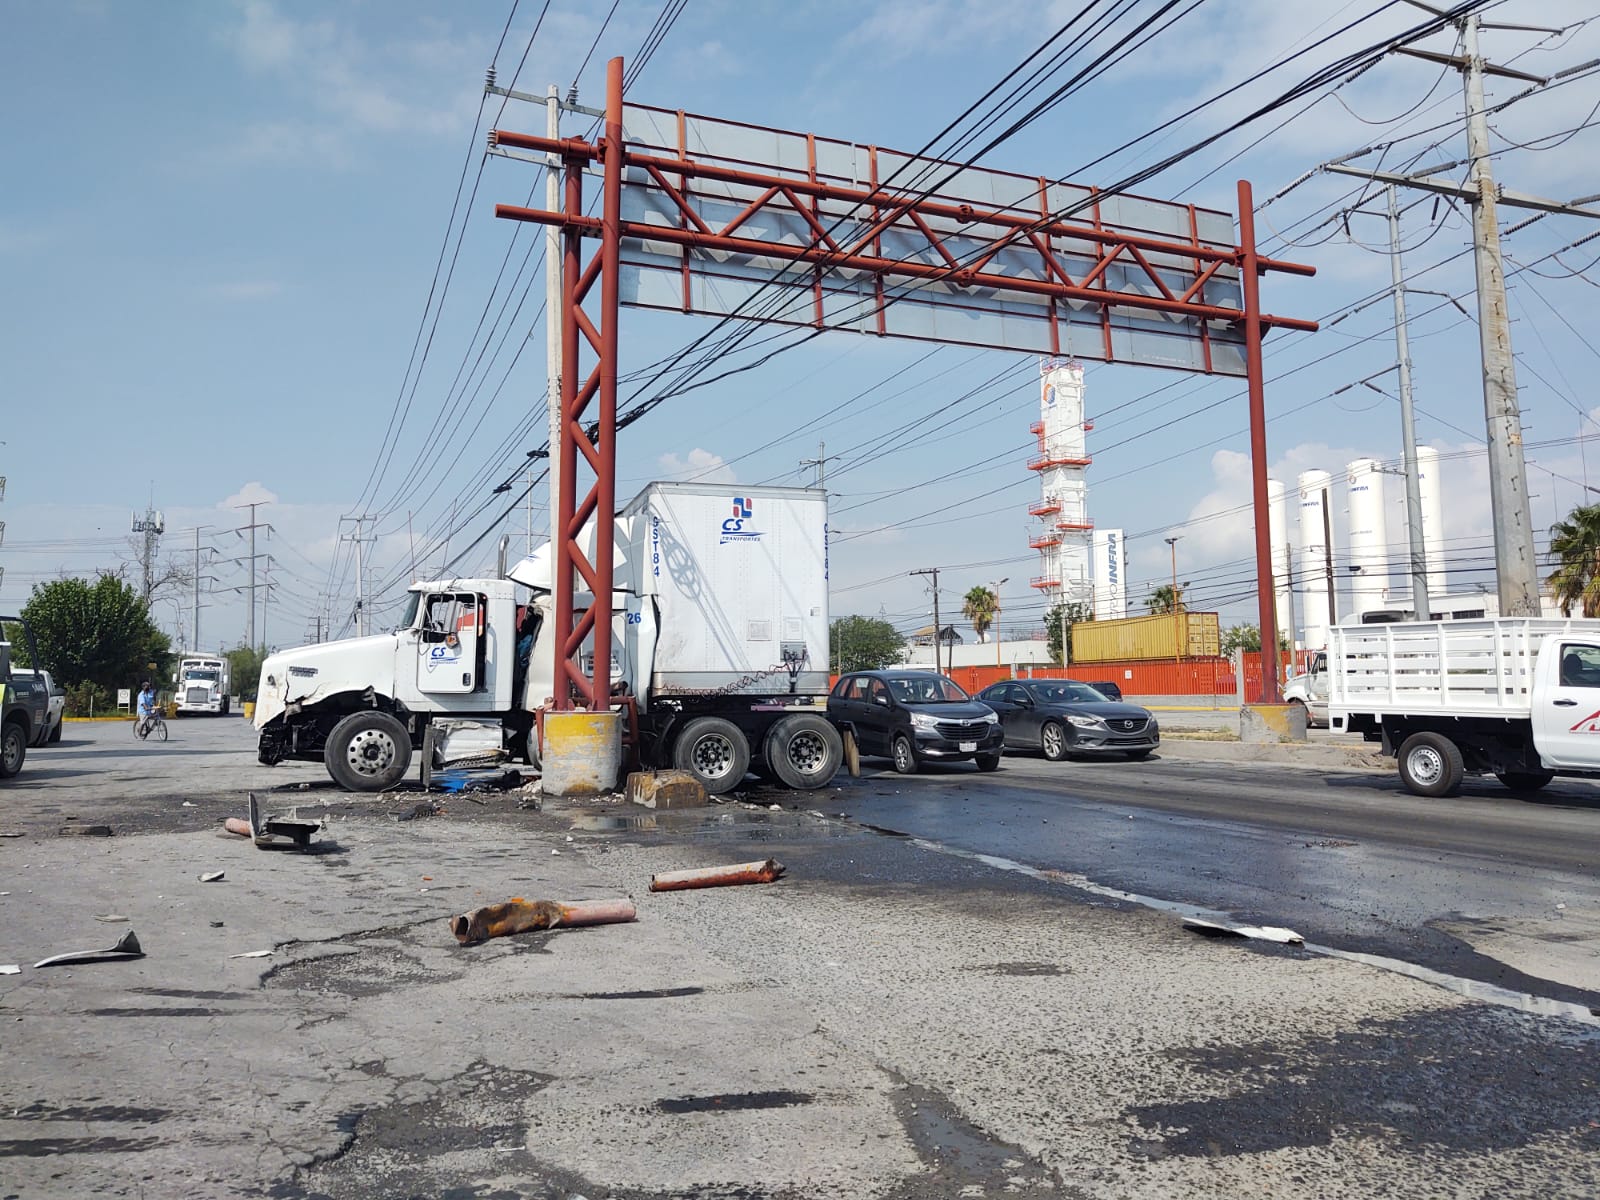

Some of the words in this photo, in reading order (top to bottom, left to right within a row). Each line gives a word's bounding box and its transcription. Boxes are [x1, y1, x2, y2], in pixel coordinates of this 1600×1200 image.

[722, 518, 744, 531] CS
[627, 612, 642, 625] 26
[431, 647, 447, 657] CS
